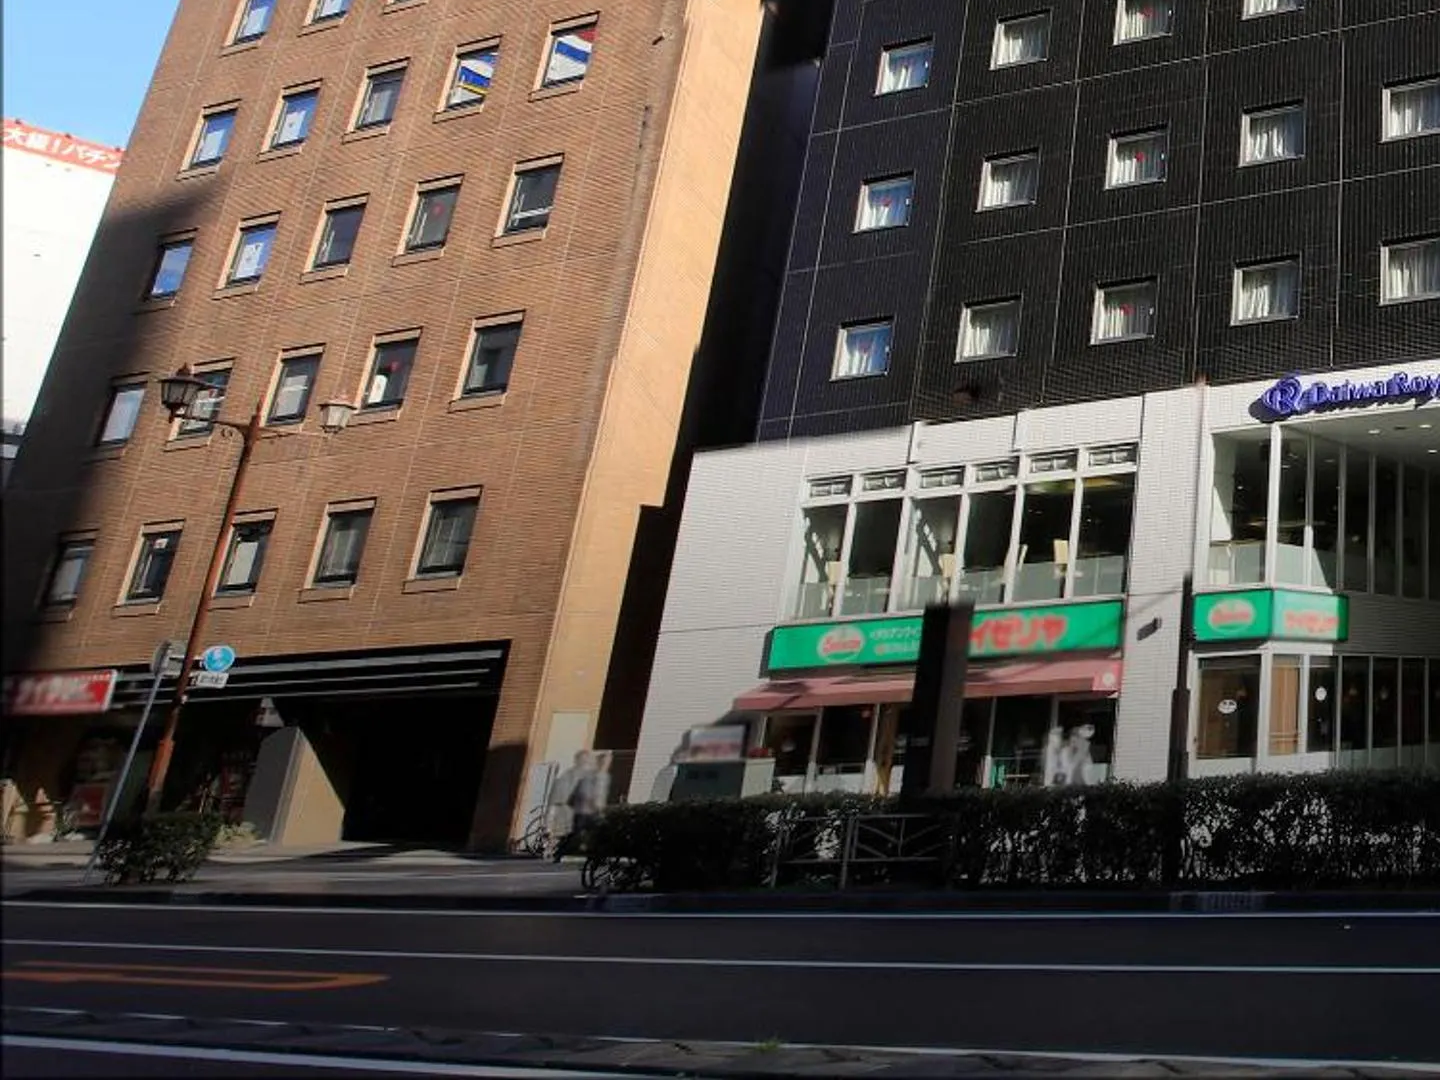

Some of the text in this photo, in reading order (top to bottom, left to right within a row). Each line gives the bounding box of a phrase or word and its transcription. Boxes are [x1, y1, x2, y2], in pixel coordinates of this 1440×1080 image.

[1304, 380, 1388, 409] Daiwa
[968, 611, 1069, 653] イゼリヤ
